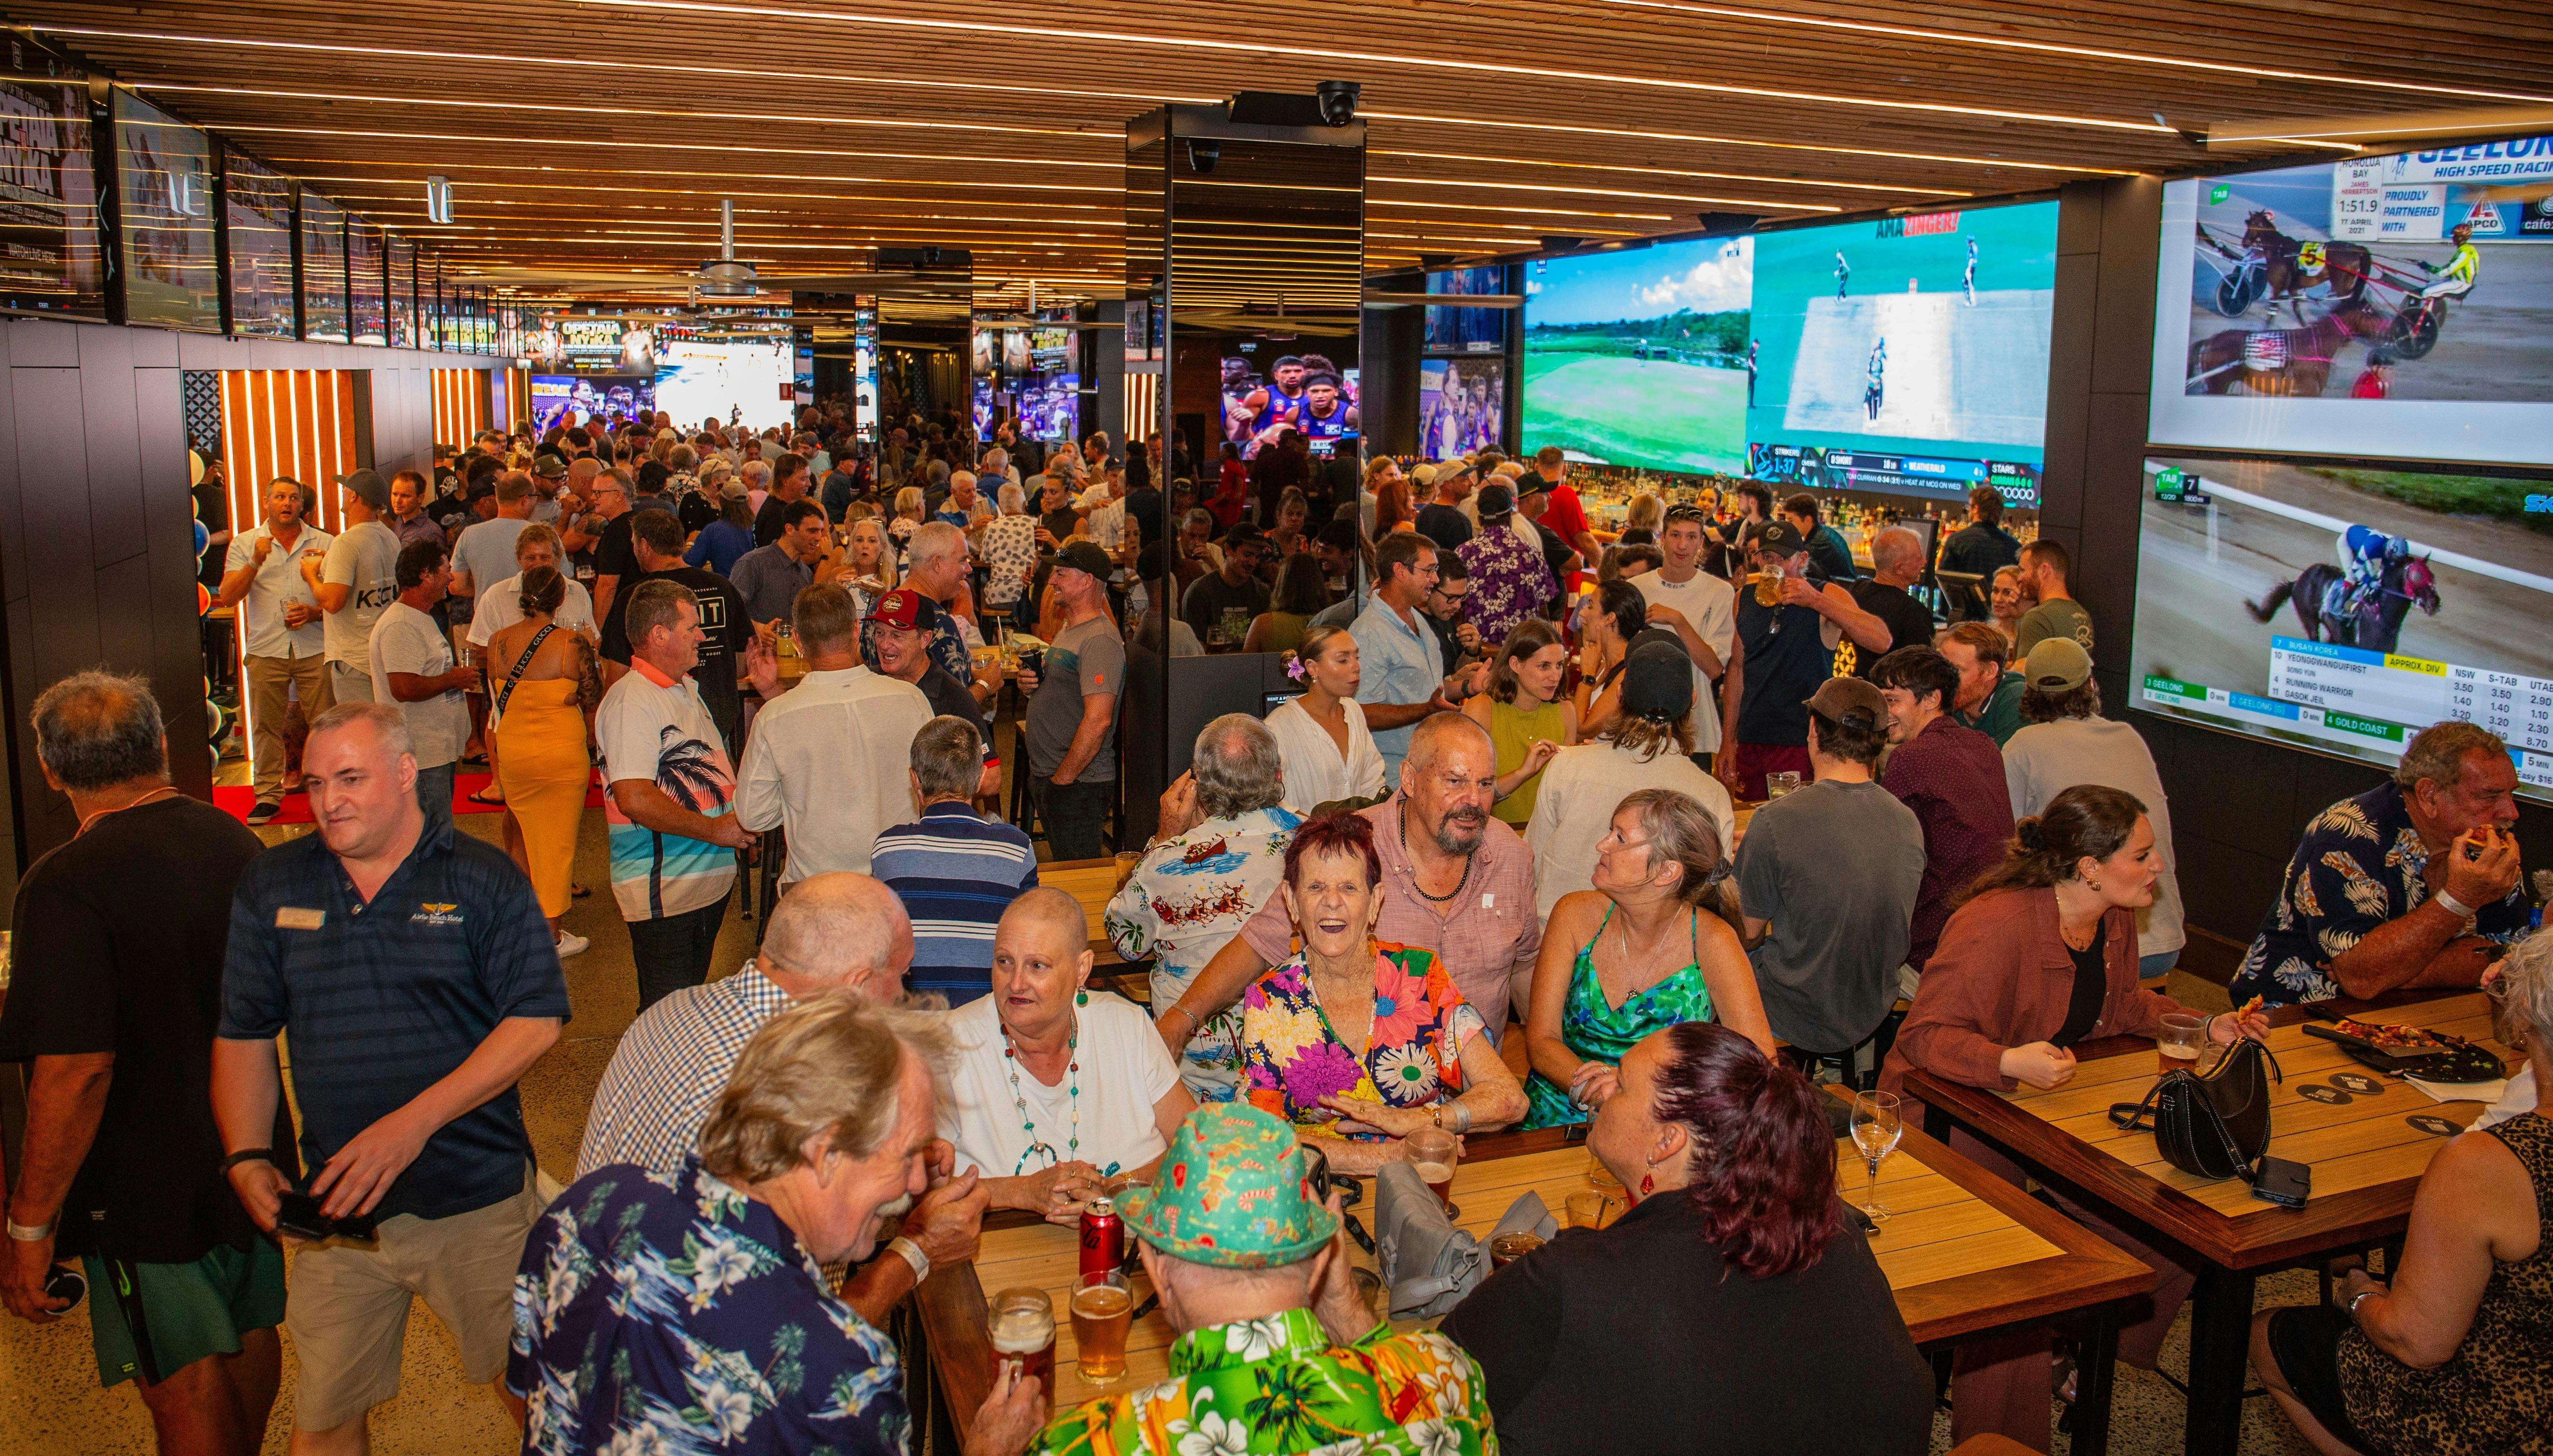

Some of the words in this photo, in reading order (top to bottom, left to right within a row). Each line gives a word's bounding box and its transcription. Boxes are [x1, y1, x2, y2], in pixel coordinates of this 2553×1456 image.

[2353, 169, 2369, 178] BAY
[2434, 166, 2466, 177] HIGH
[2468, 163, 2511, 176] SPEED
[2385, 191, 2428, 200] PROUDLY
[2340, 200, 2377, 212] 1:51.9
[2382, 207, 2440, 216] PARTNERED
[2382, 222, 2406, 231] WITH
[562, 322, 621, 335] OPETAIA
[1775, 447, 1800, 457] STRIKERS
[1774, 458, 1796, 474] 1-37
[1801, 459, 1816, 467] OVERS
[1991, 463, 2015, 475] STARS
[1857, 474, 1877, 482] CURRAN
[1905, 478, 1918, 486] HEAT
[1947, 482, 1961, 490] WED
[1991, 475, 2015, 486] CURRAN
[2161, 473, 2177, 483] TAB
[2187, 478, 2195, 491] 7
[533, 626, 553, 646] GUCCI
[515, 650, 533, 673] GUCCI
[2390, 658, 2423, 671] APPROX.
[2426, 664, 2440, 673] DIV
[2455, 669, 2475, 679] NSW
[2488, 675, 2517, 686] S-TAB
[2152, 680, 2183, 693] GEELONG
[2285, 678, 2318, 690] RUNNING
[2319, 684, 2353, 697] WARRIOR
[2454, 682, 2473, 693] 3.50
[2154, 693, 2180, 703] GEELONG
[2491, 689, 2512, 699] 3.50
[2238, 698, 2272, 711] GEELONG
[2453, 696, 2471, 706] 1.40
[2530, 695, 2552, 706] 2.90
[2491, 702, 2510, 713] 1.40
[2452, 709, 2471, 720] 3.20
[2531, 710, 2548, 720] 1.10
[2327, 716, 2333, 725] 4
[2335, 717, 2358, 730] GOLD
[2358, 721, 2387, 735] COAST
[2489, 716, 2509, 727] 3.20
[2527, 723, 2549, 734] 2.30
[2526, 737, 2548, 748] 8.70
[2528, 757, 2535, 766] 5
[2536, 761, 2550, 769] MIN
